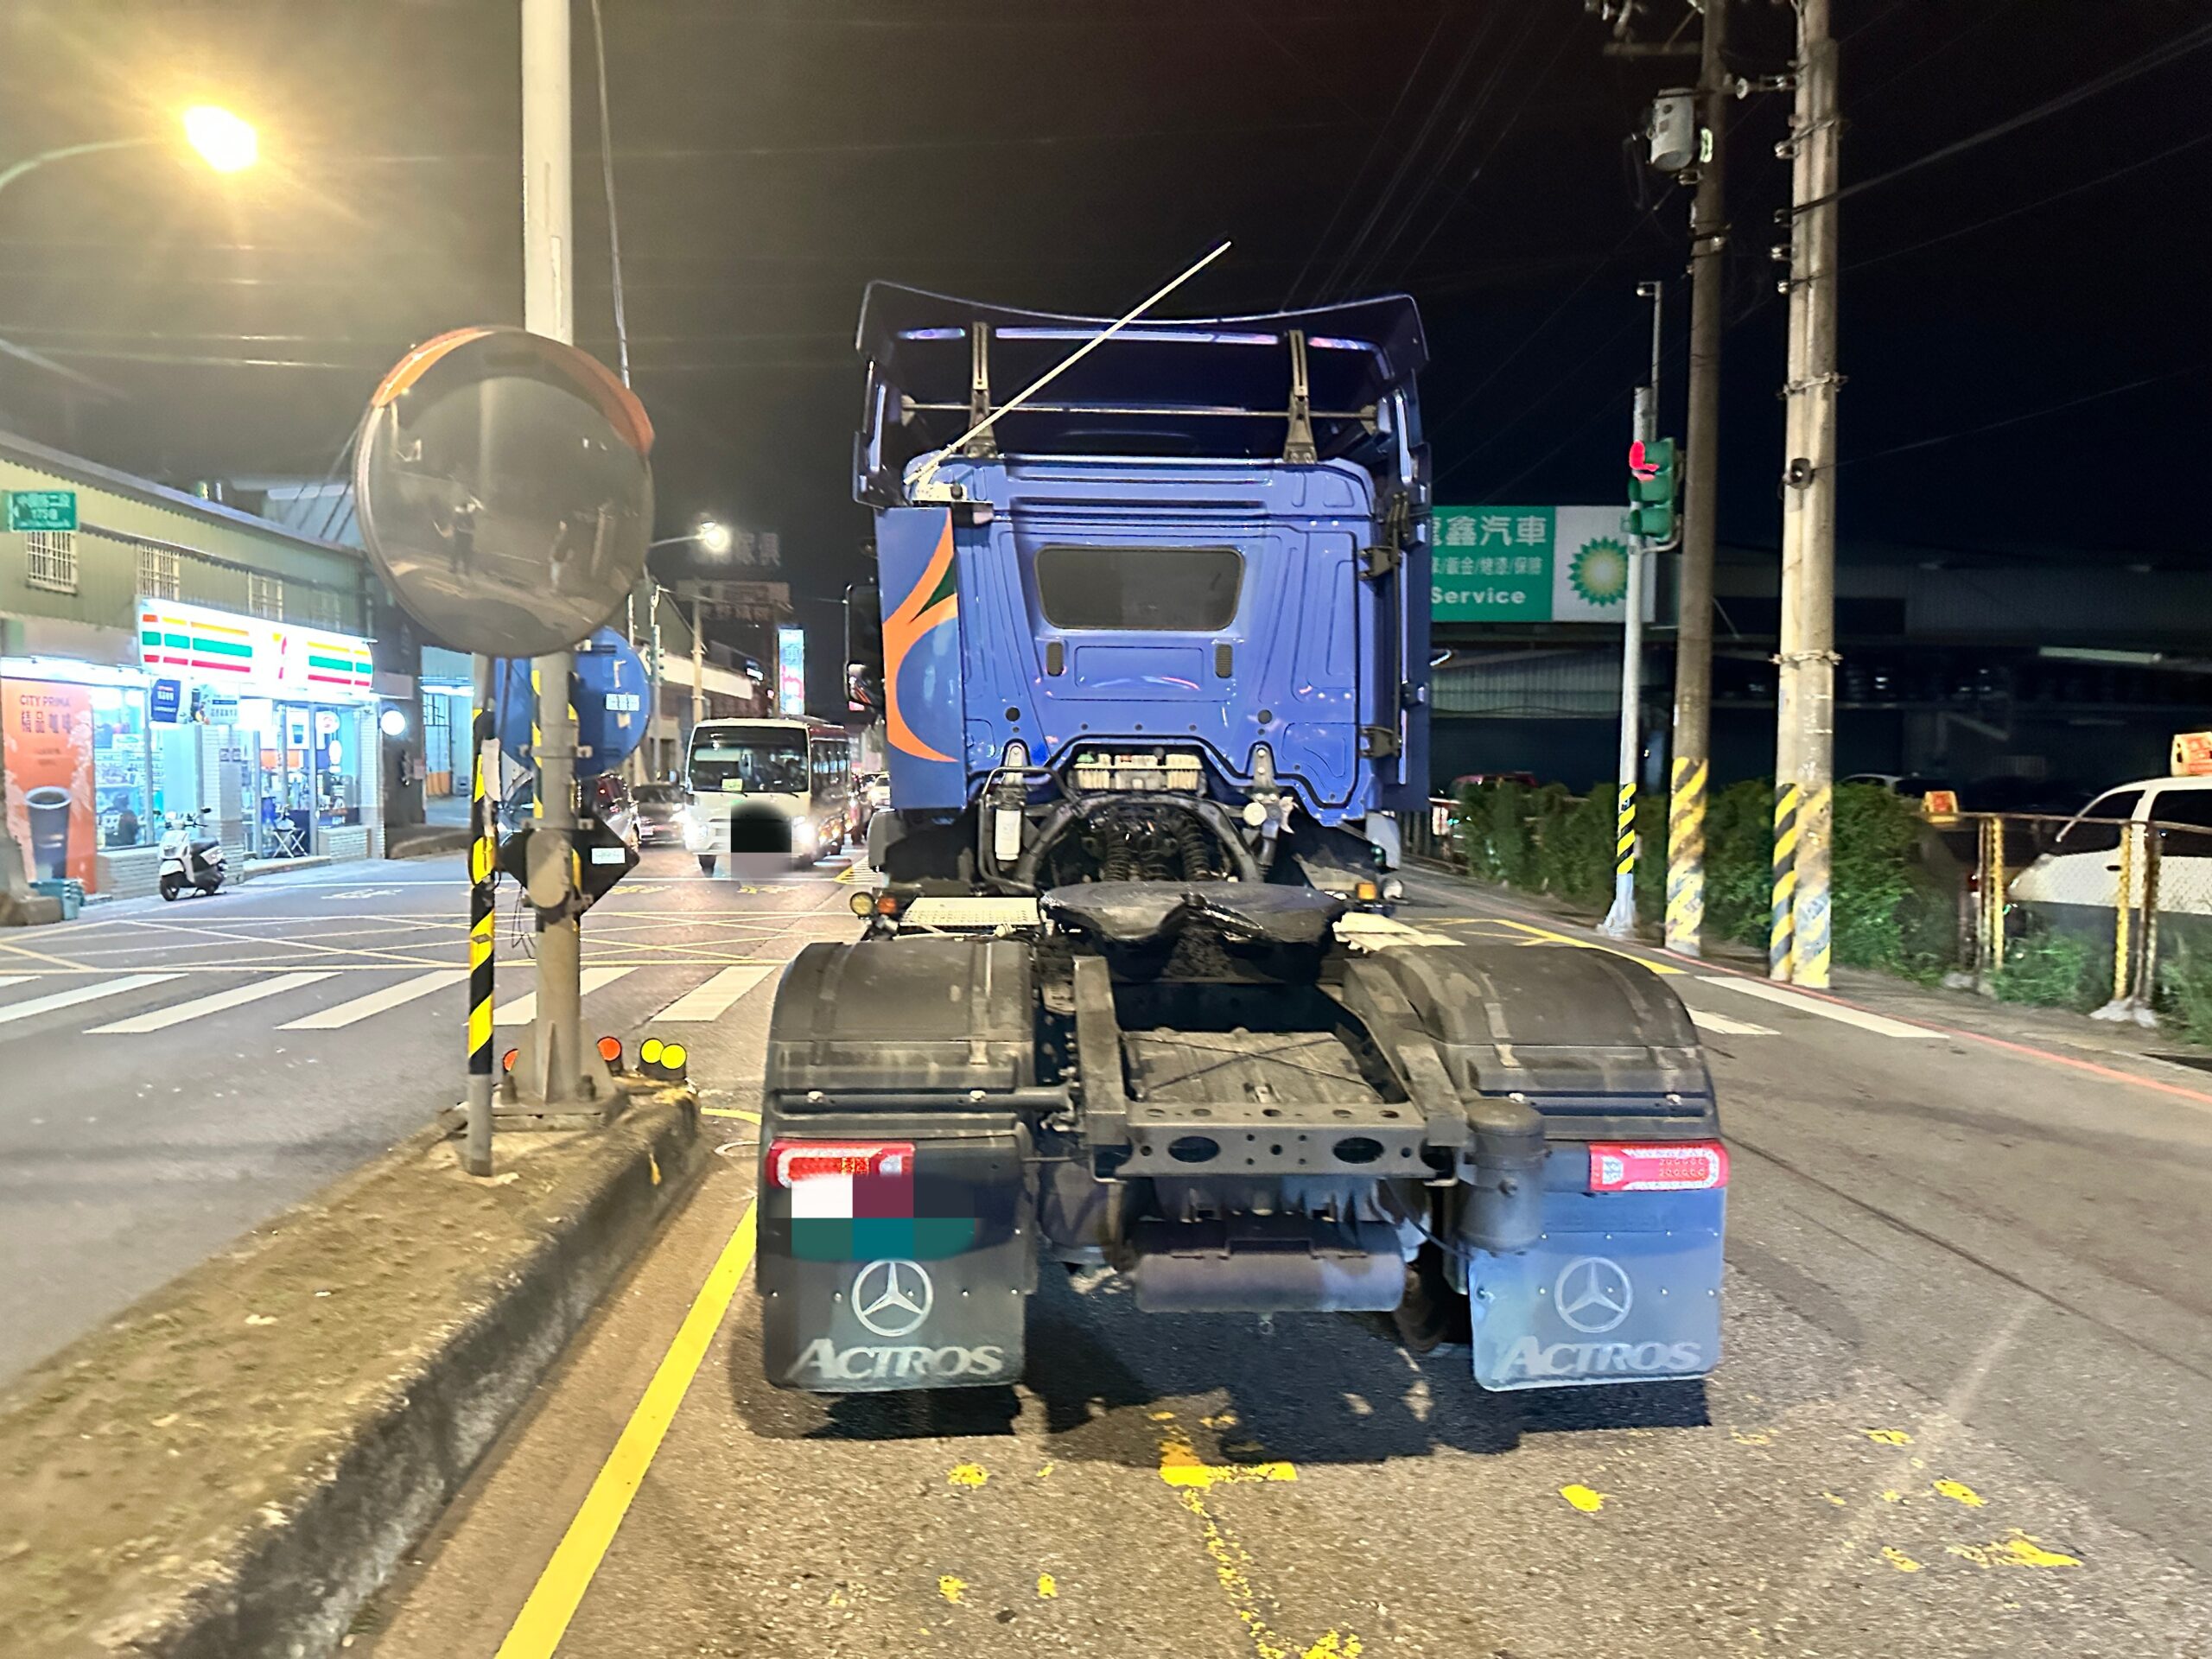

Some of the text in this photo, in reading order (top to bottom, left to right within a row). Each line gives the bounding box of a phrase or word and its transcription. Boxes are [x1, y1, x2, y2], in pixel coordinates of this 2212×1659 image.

[1431, 586, 1526, 604] Service
[20, 695, 41, 706] CITY
[785, 1338, 1004, 1379] ACTROS
[1492, 1336, 1701, 1380] ACTROS
